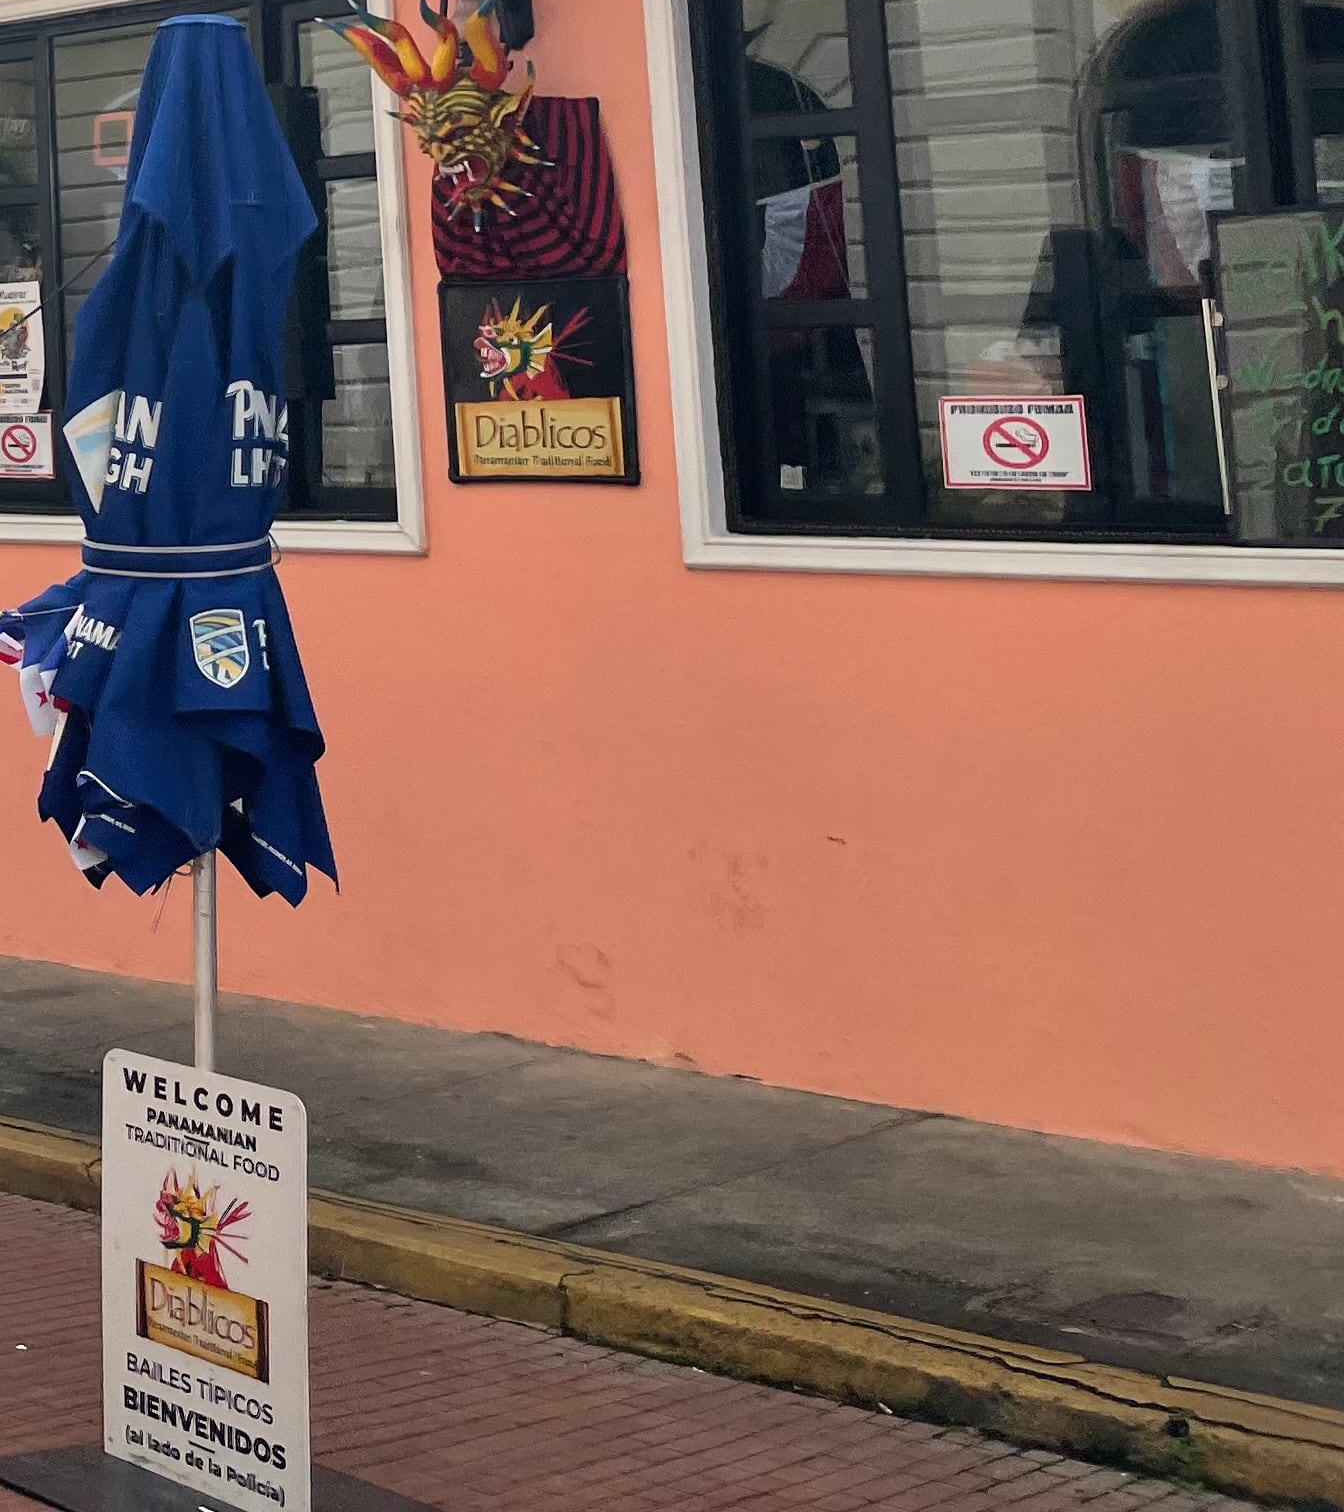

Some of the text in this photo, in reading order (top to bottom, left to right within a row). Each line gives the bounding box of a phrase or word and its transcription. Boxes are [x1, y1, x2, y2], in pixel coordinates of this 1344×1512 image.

[475, 408, 607, 452] Diablicos
[123, 1067, 283, 1132] WELCOME
[147, 1107, 256, 1152] PANAMANIAN
[125, 1124, 279, 1182] TRADITIONAL FOOD
[151, 1278, 257, 1349] Diablicos
[127, 1352, 274, 1425] BAILES TÍPICOS
[123, 1385, 287, 1470] BIENVENIDOS
[126, 1424, 144, 1444] (al
[148, 1433, 181, 1461] lado
[185, 1451, 204, 1471] de
[209, 1458, 221, 1478] la
